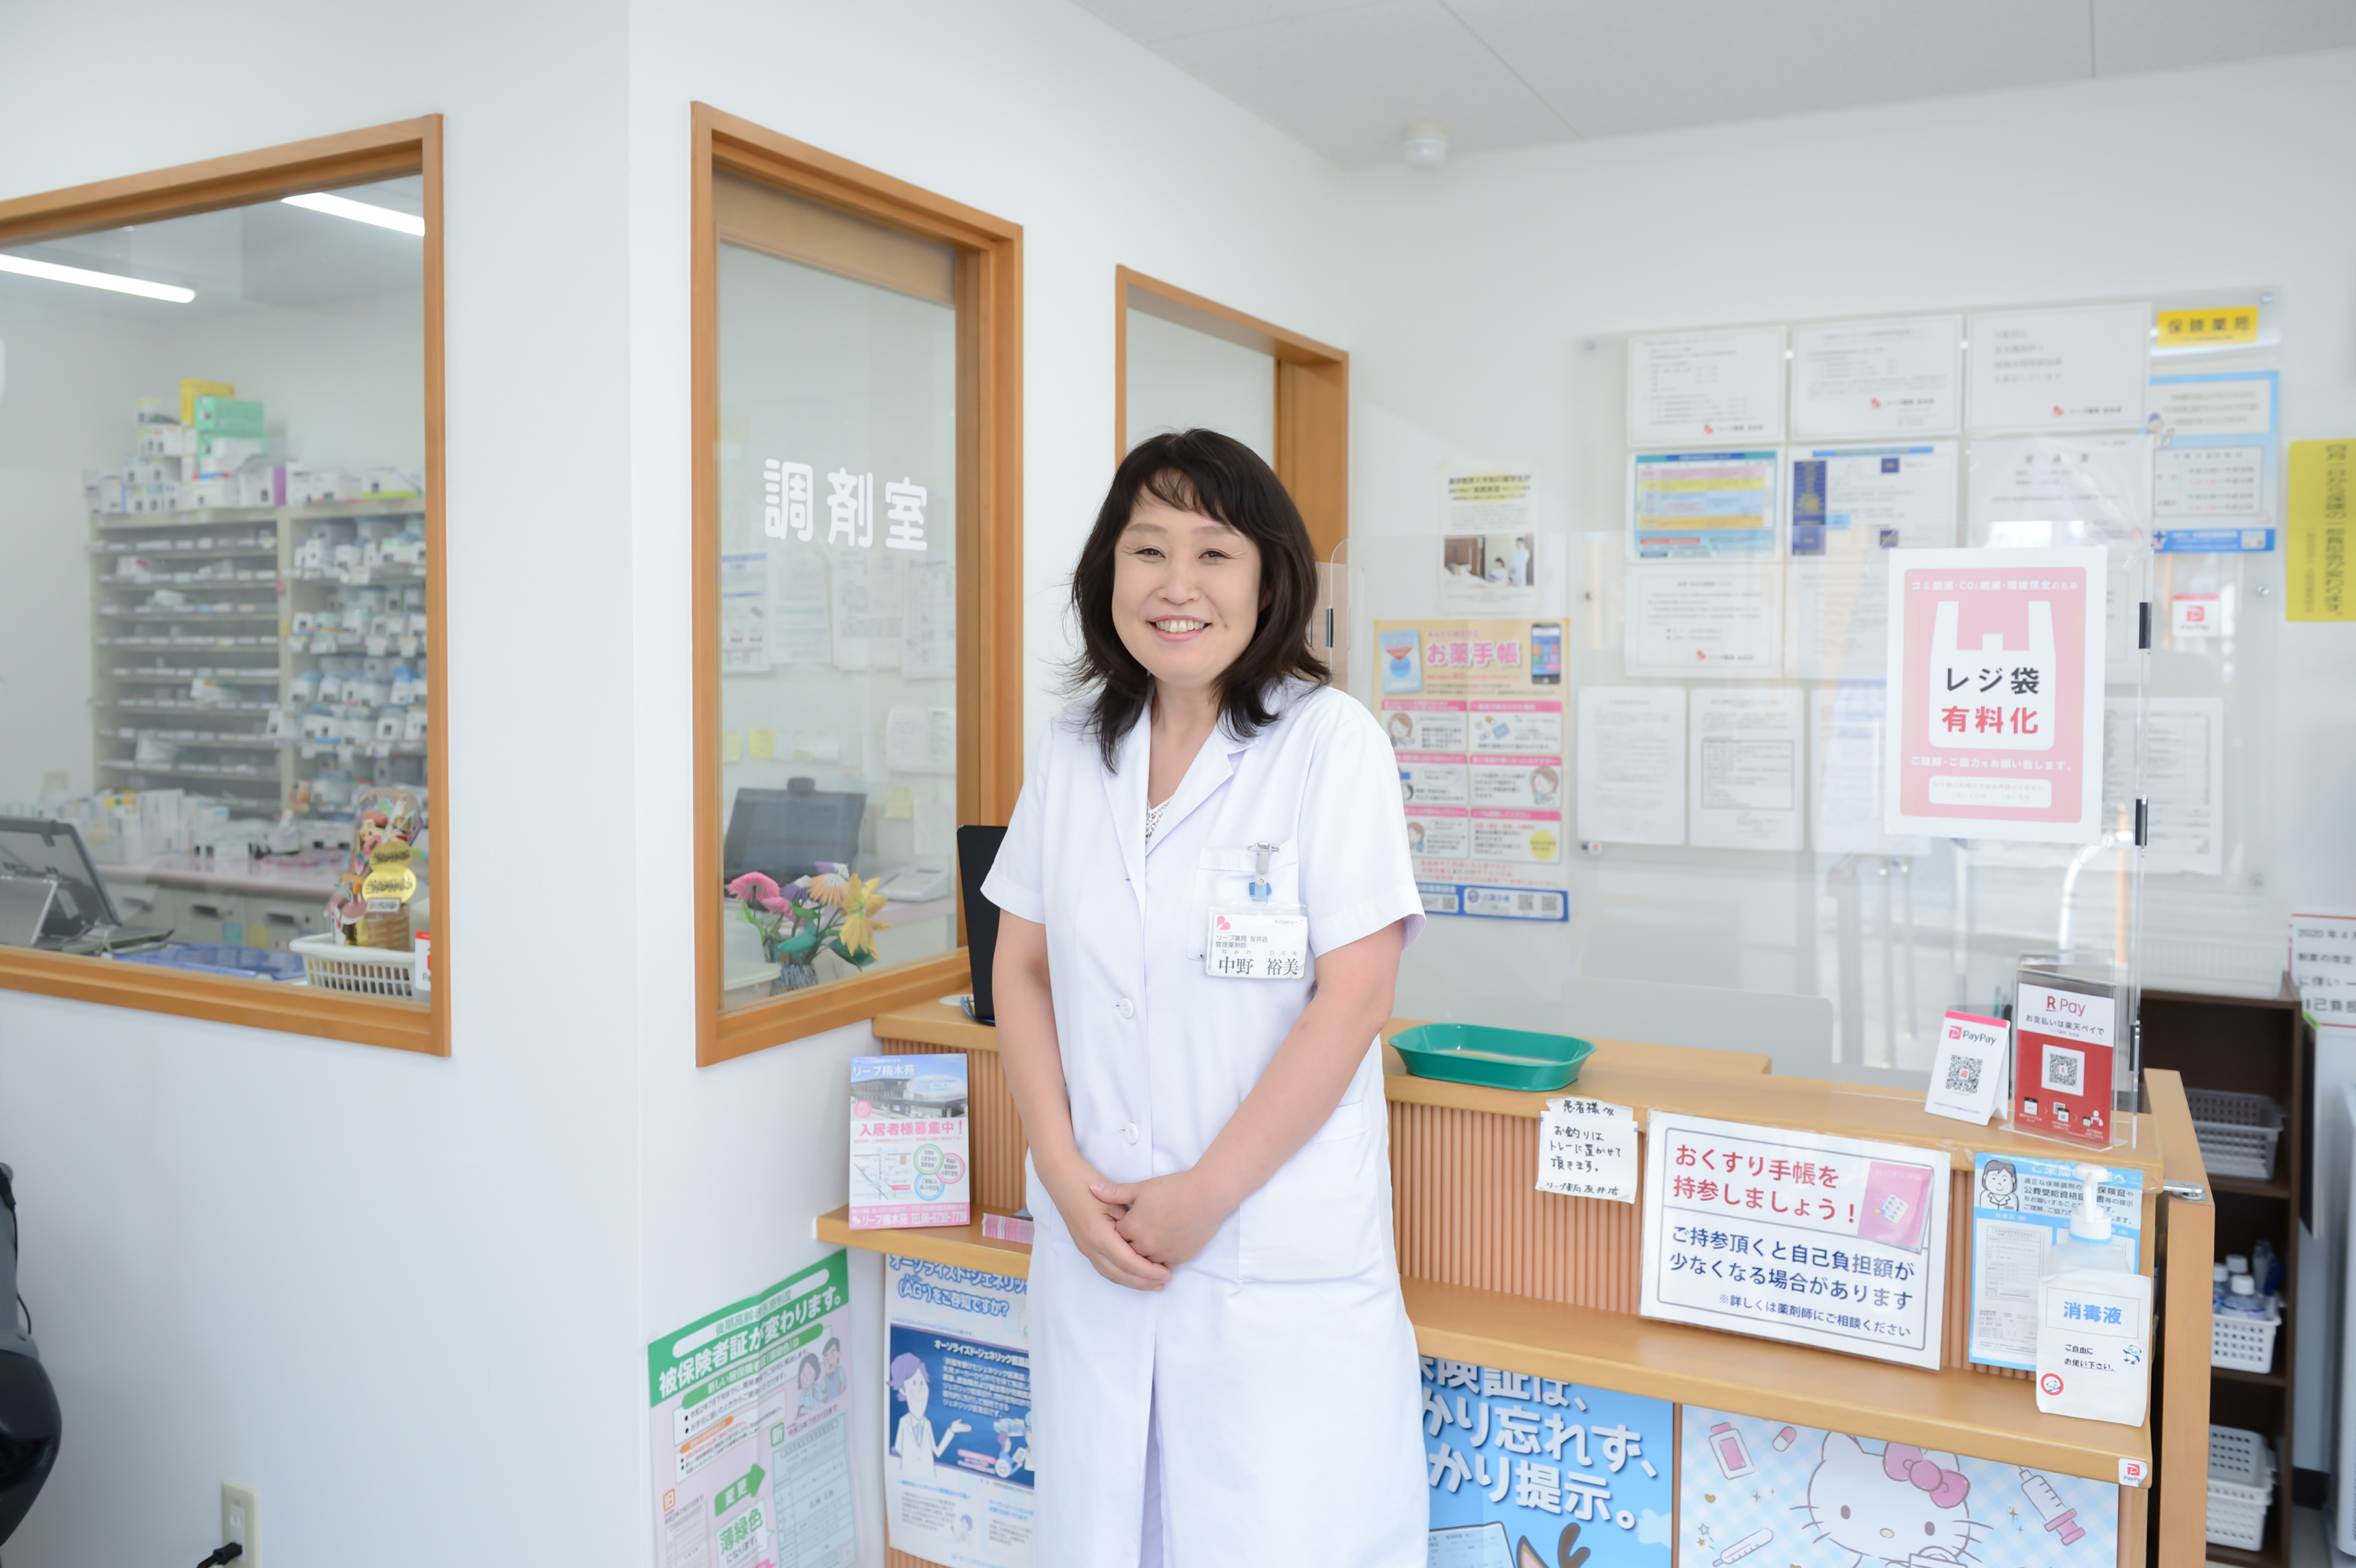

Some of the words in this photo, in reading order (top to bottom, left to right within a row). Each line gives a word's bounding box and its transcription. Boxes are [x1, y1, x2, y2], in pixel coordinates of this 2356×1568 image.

[2168, 316, 2250, 335] 保険薬局
[763, 458, 927, 551] 調剤室
[1427, 642, 1518, 665] お薬手帳
[1947, 667, 2040, 695] レジ袋
[1942, 706, 2039, 734] 有料化
[1911, 756, 2072, 772] ご理解・ご協力をお願い致します。
[1219, 956, 1254, 975] 中野
[1266, 958, 1298, 976] 裕美
[2046, 995, 2057, 1012] R
[2060, 998, 2086, 1017] Pay
[1963, 1029, 1997, 1045] PayPay
[2026, 1014, 2105, 1036] お支払いは楽天ペイで
[860, 1120, 962, 1136] 入居者様募集中!
[1554, 1125, 1604, 1141] お釣りは
[1550, 1140, 1621, 1157] トレーに置かせて
[1550, 1155, 1599, 1173] 頂きます。
[1675, 1144, 1840, 1189] おくすり手帳を
[1673, 1175, 1855, 1223] 持参しましょう!
[1672, 1225, 1915, 1281] ご持参頂くと自己負担額が
[1669, 1252, 1913, 1310] 少なくなる場合があります
[716, 1289, 792, 1335] 後期高齢者医療制度
[1719, 1294, 1911, 1337] ※詳しくは薬剤師にご相談ください
[2063, 1301, 2122, 1325] 消毒液
[659, 1286, 841, 1399] 被保険者証が変わります。
[2065, 1344, 2094, 1354] ご自由に
[2064, 1358, 2115, 1371] お使い下さい。
[1423, 1387, 1658, 1478] かり忘れず、
[724, 1477, 748, 1508] 変更
[1429, 1442, 1636, 1530] かり提示。
[665, 1491, 675, 1510] 旧
[720, 1507, 764, 1556] 薄緑色
